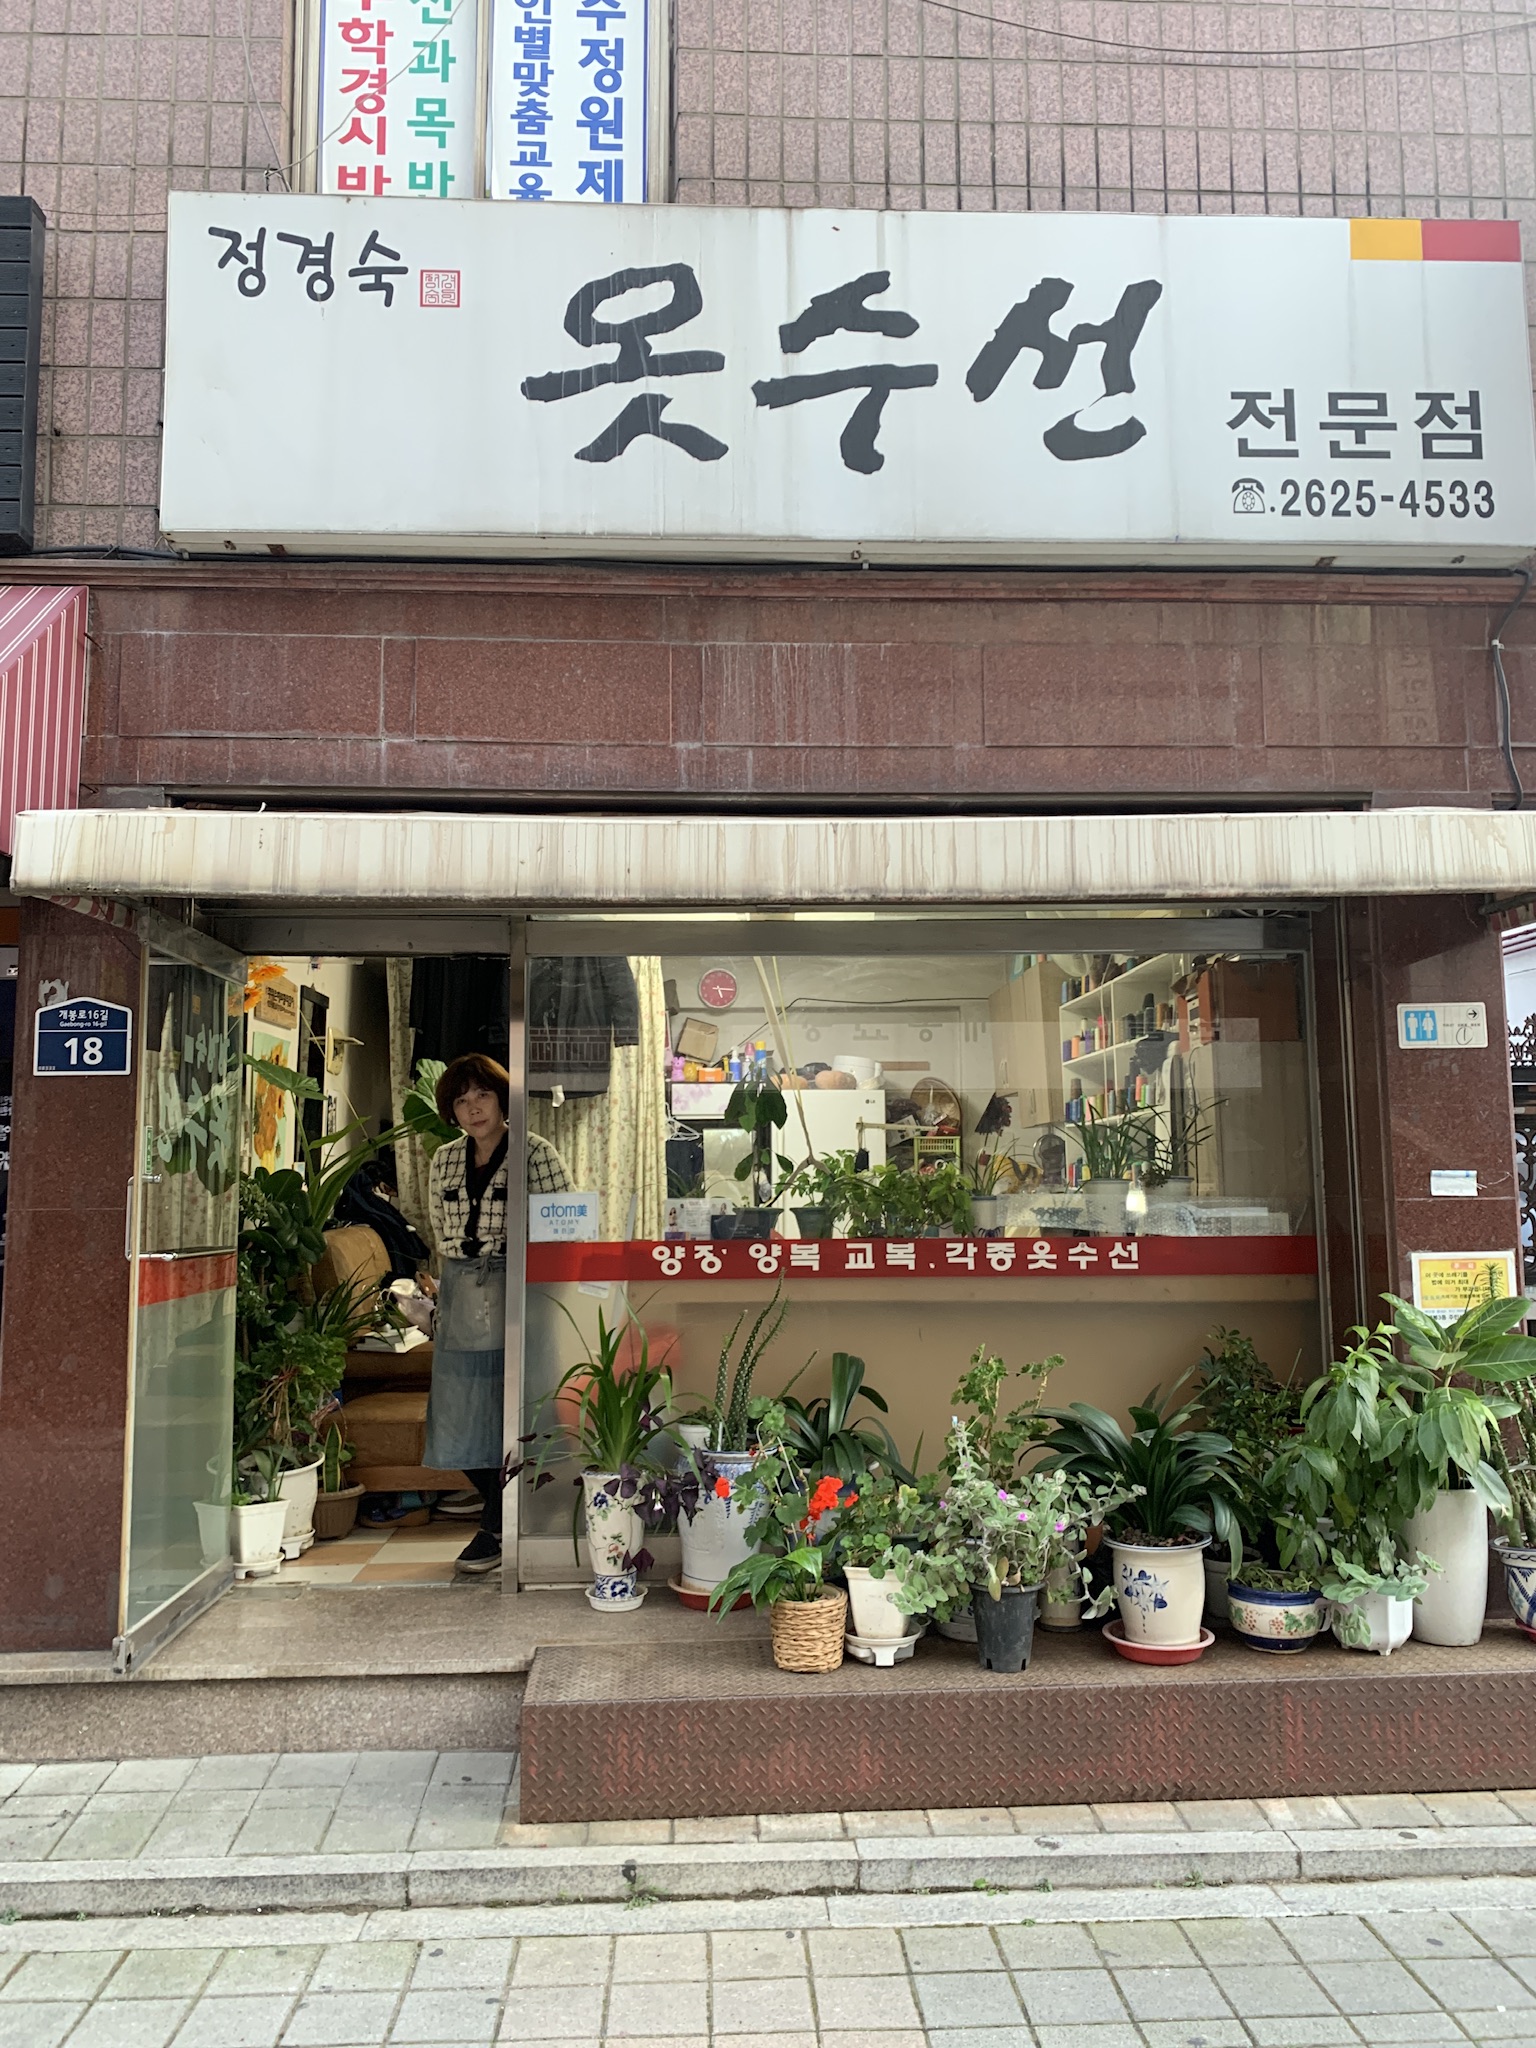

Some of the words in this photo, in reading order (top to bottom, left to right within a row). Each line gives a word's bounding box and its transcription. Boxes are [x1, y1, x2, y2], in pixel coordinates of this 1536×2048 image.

[338, 0, 395, 196] 학경시반
[208, 226, 409, 308] 정경숙
[522, 262, 1163, 474] 옷수선
[1226, 388, 1484, 460] 전문점
[58, 1009, 109, 1021] 개봉로16길
[59, 1020, 91, 1028] Gaebong-ro
[92, 1020, 107, 1028] 16-gil
[64, 1036, 104, 1066] 18
[748, 1243, 821, 1274] 양복
